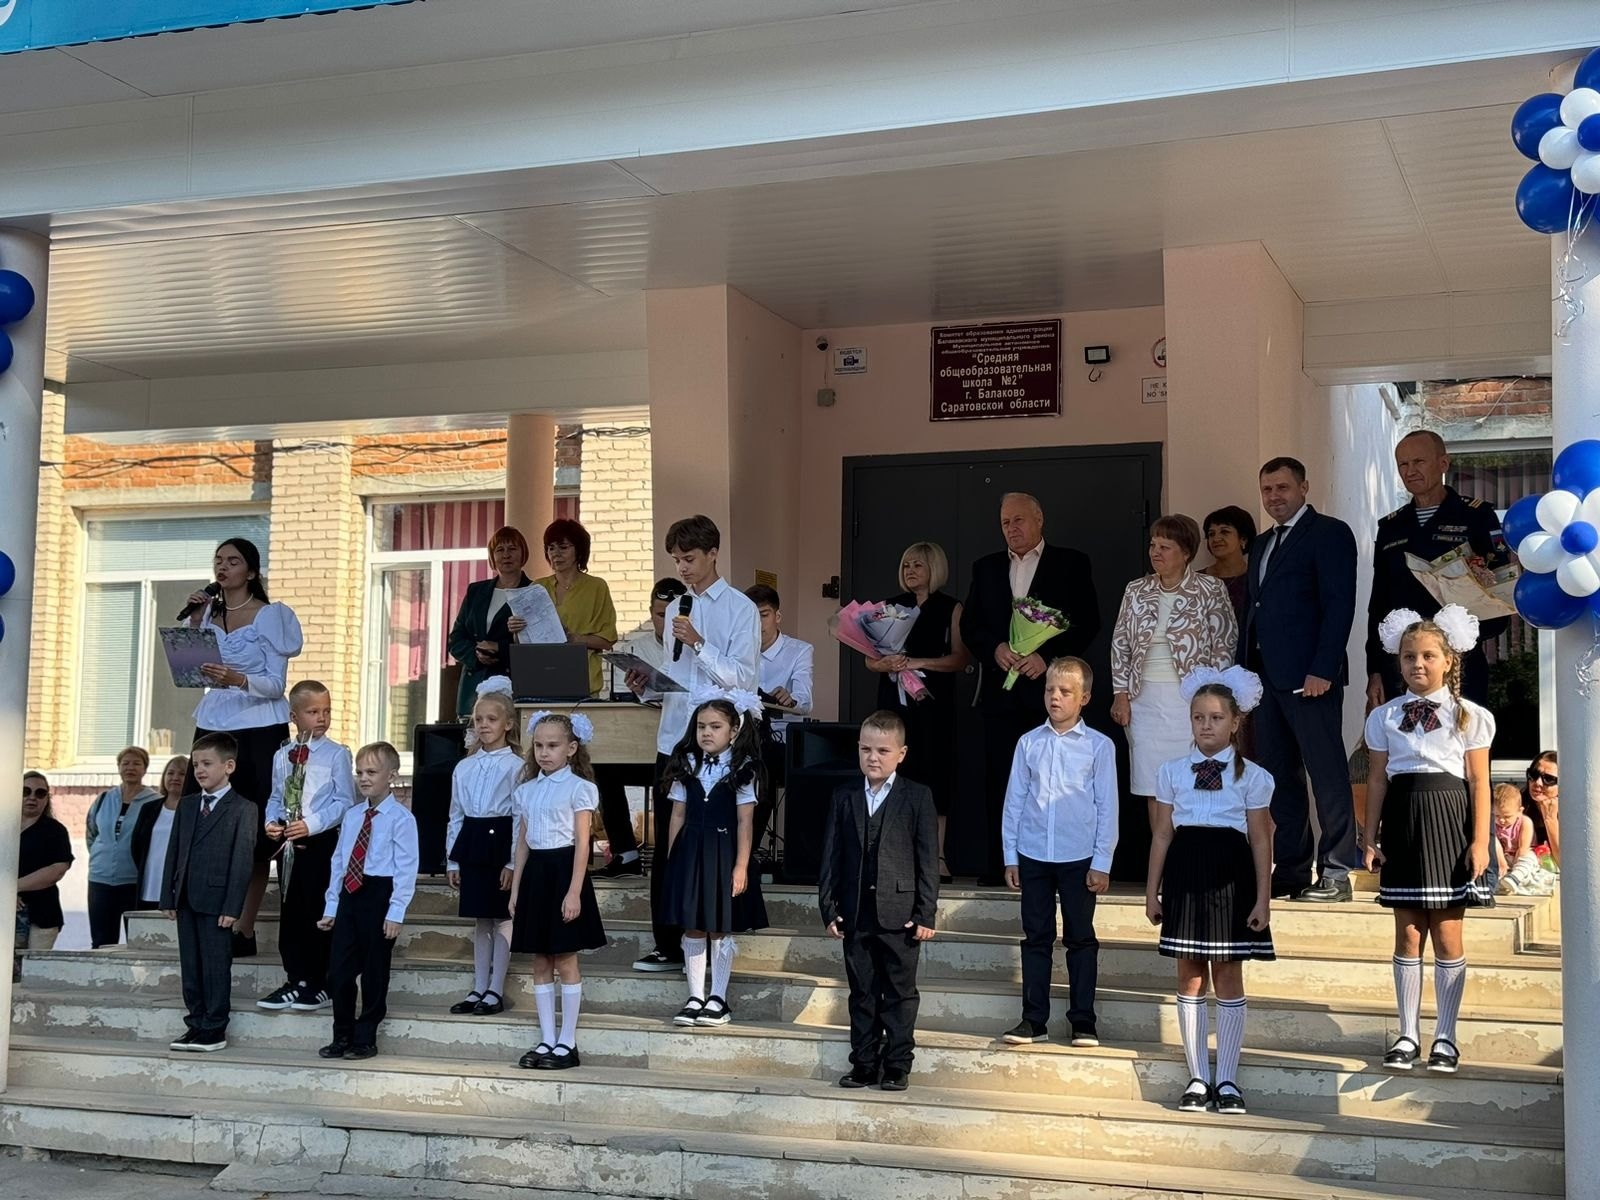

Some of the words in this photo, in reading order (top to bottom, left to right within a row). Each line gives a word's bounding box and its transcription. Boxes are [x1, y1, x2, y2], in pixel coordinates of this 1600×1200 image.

[940, 362, 1052, 378] общеобразовательная
[962, 378, 992, 388] школа
[966, 392, 972, 400] г.
[978, 388, 1025, 400] Балаково
[1010, 398, 1051, 409] области
